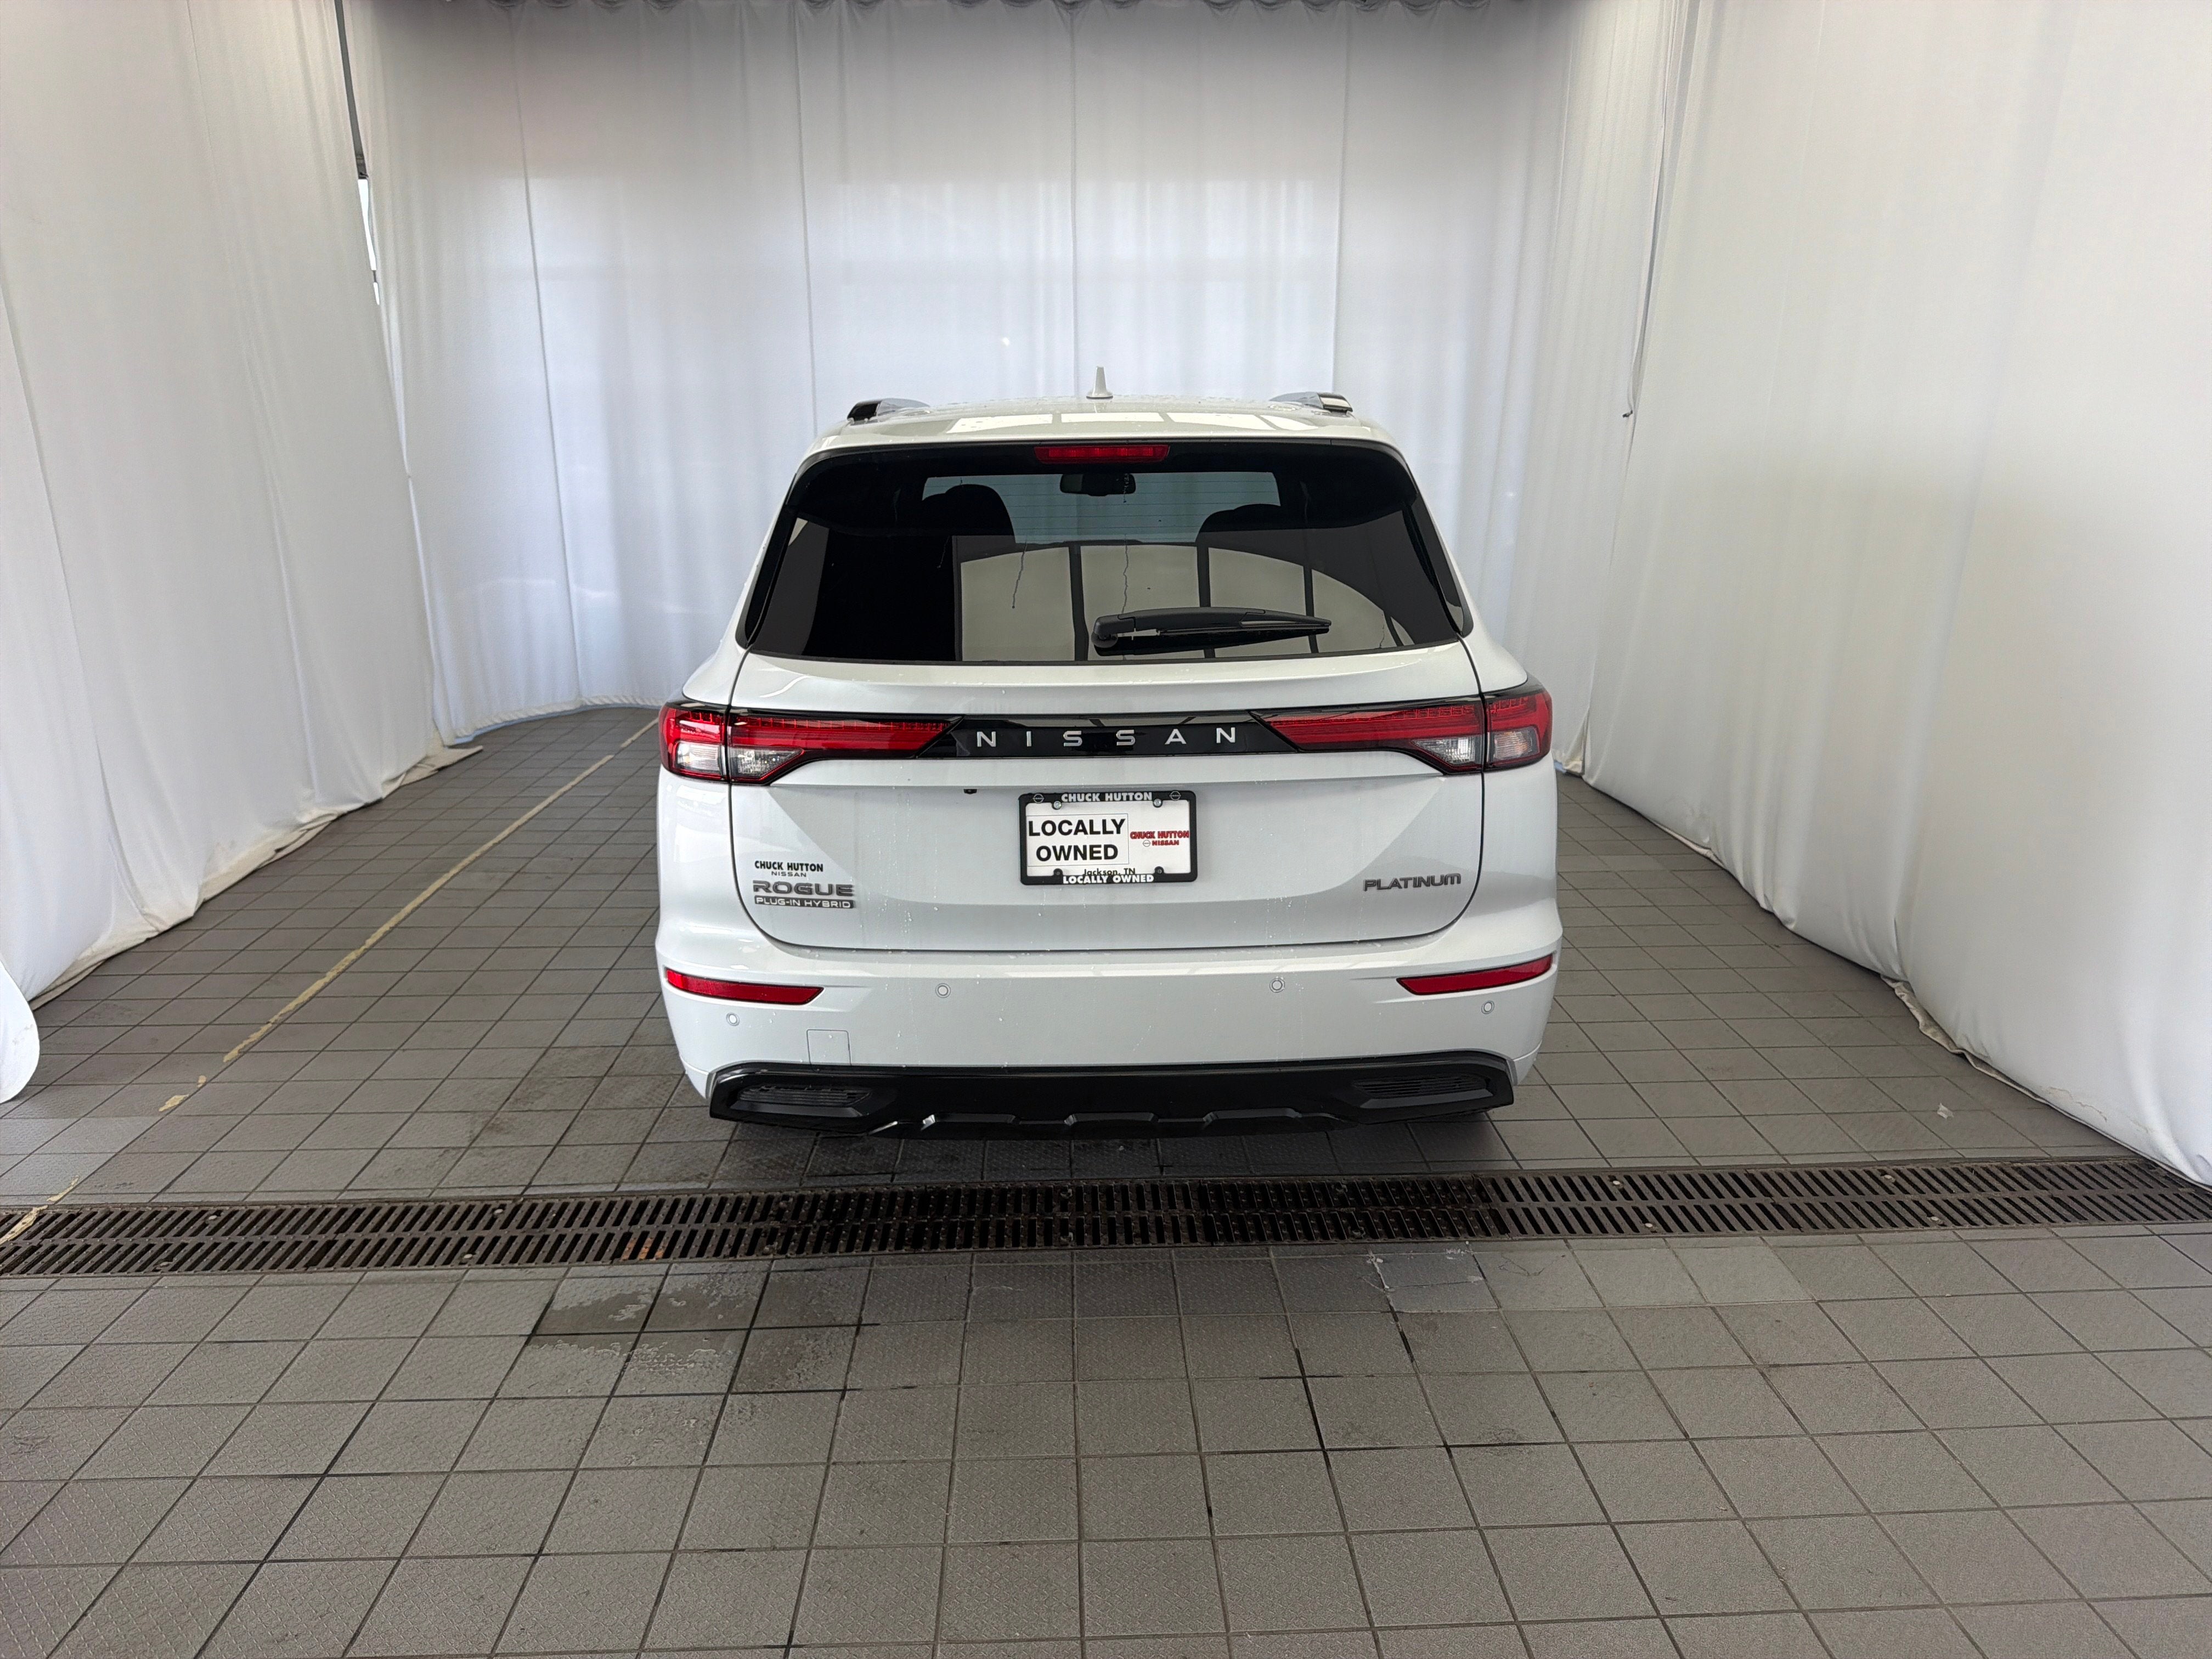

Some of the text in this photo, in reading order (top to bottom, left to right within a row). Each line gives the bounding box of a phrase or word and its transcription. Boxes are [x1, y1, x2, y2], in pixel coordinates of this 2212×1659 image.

[977, 726, 1236, 747] NISSAN
[1061, 792, 1153, 802] CHUCK HUTTON
[1028, 819, 1126, 837] LOCALLY
[1157, 830, 1189, 838] HUTTON
[1036, 844, 1119, 861] OWNED
[754, 860, 823, 872] CHUCK HUTTON
[1063, 874, 1154, 884] LOCALLY OWNED
[1363, 873, 1462, 891] PLATINUM
[753, 880, 854, 896] ROGUE
[756, 897, 851, 909] PLUG-IN HYBRID
